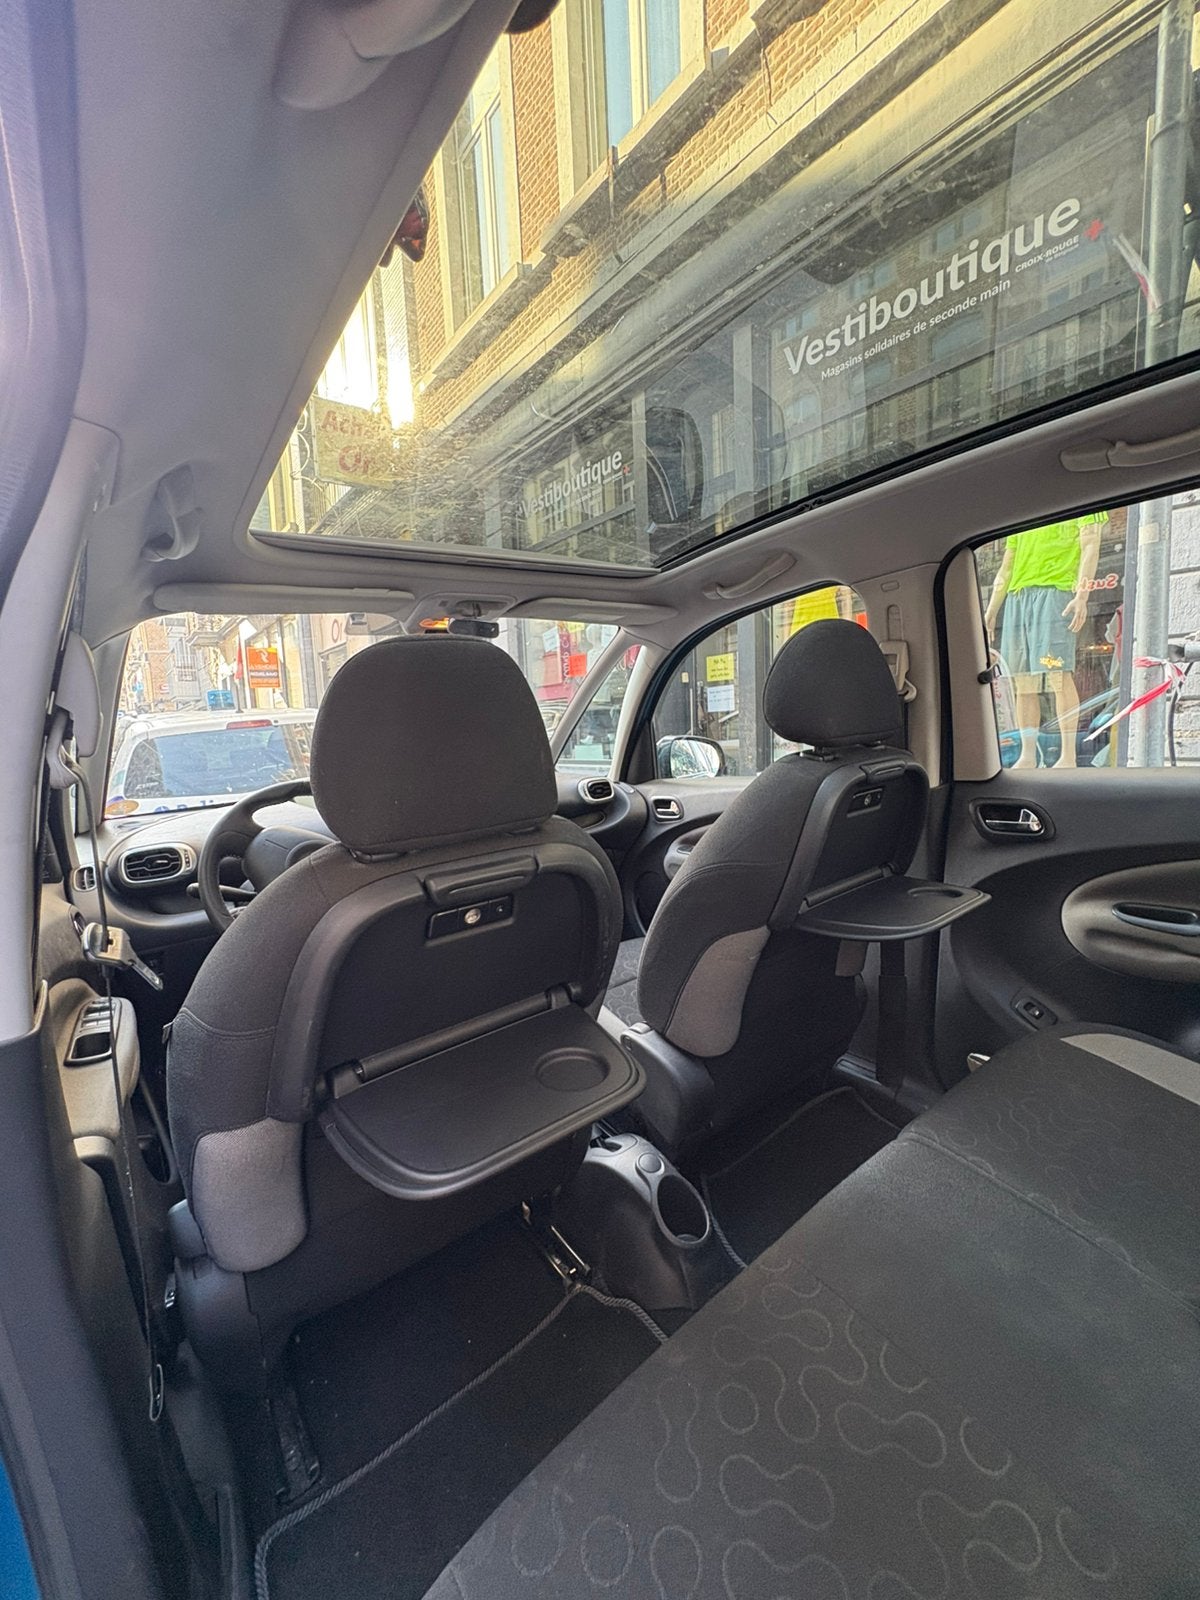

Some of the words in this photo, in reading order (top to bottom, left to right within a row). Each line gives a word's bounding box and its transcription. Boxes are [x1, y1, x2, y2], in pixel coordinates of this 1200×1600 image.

[783, 198, 1081, 375] Vestiboutique
[1015, 234, 1079, 273] CROIX-ROUGE
[821, 355, 863, 381] Magasins
[864, 328, 911, 359] solidaires
[913, 322, 927, 335] de
[929, 296, 977, 327] seconde
[980, 279, 1011, 302] main
[520, 450, 622, 518] Vestiboutique
